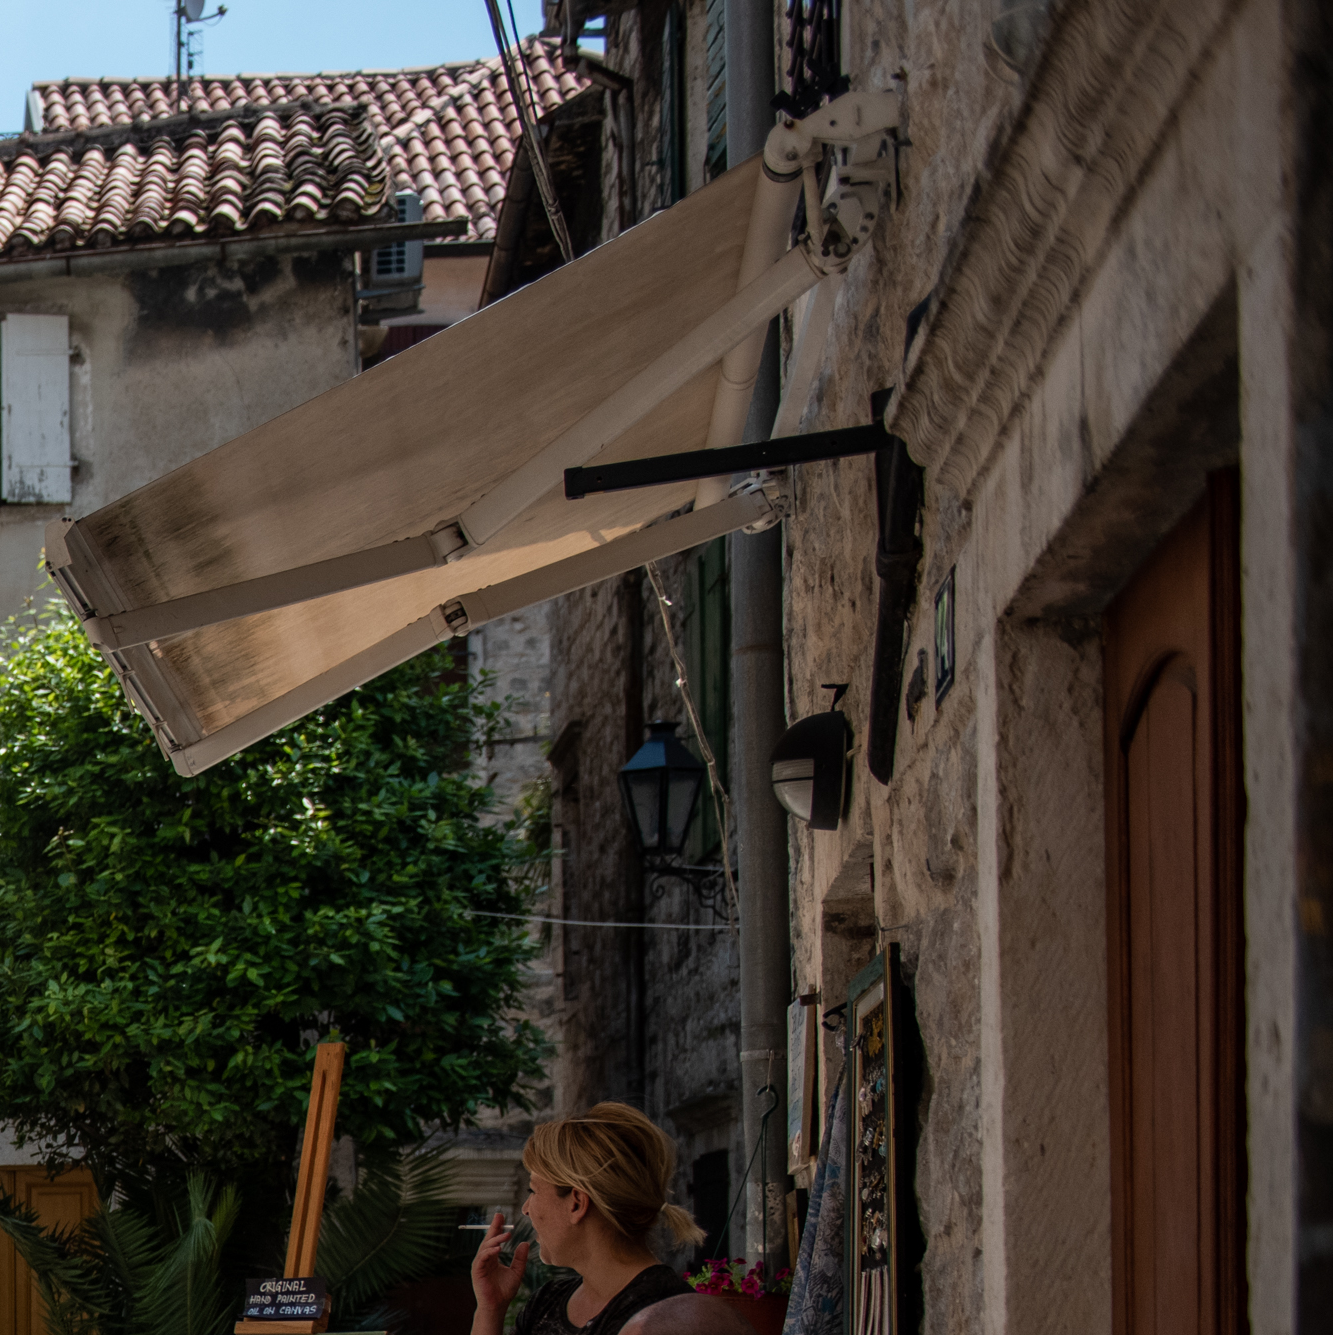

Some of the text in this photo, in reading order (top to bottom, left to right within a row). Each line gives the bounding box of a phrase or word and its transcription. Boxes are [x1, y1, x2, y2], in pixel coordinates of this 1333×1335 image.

[260, 1281, 306, 1292] ORIGINAL
[250, 1294, 315, 1304] HAND PAINTED
[279, 1306, 317, 1314] CANVAS
